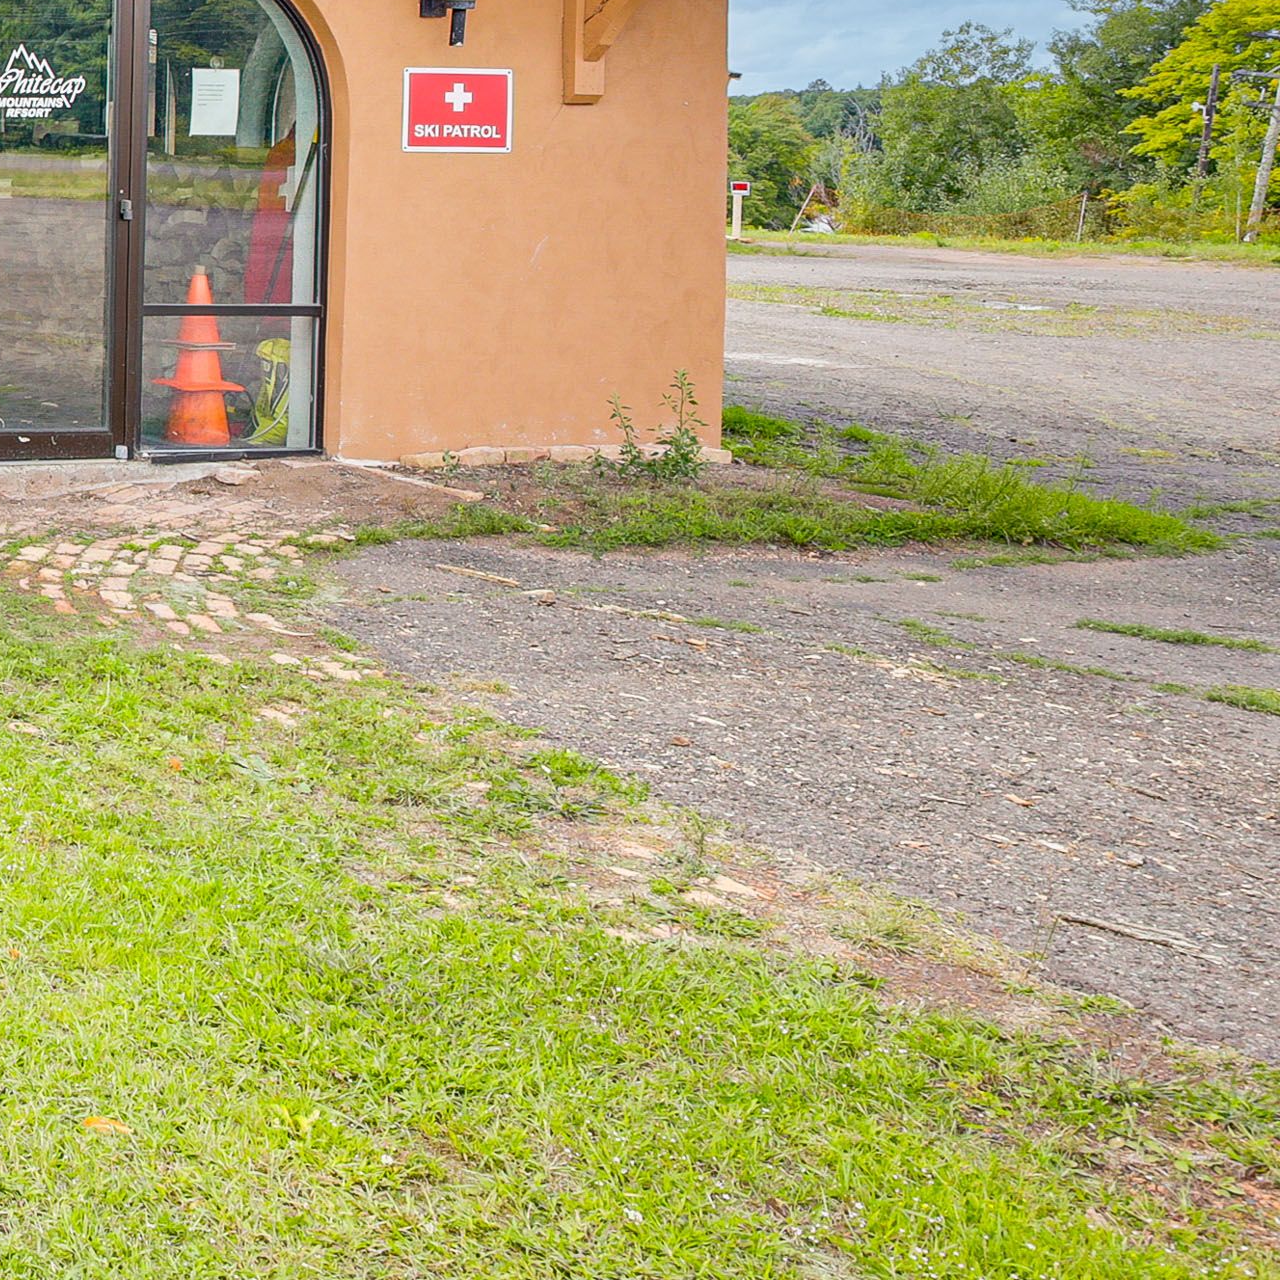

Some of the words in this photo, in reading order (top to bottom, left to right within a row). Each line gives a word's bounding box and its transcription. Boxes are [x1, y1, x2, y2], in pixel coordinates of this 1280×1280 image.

[6, 108, 52, 118] RESORT
[414, 124, 439, 138] SKI
[443, 124, 501, 139] PATROL
